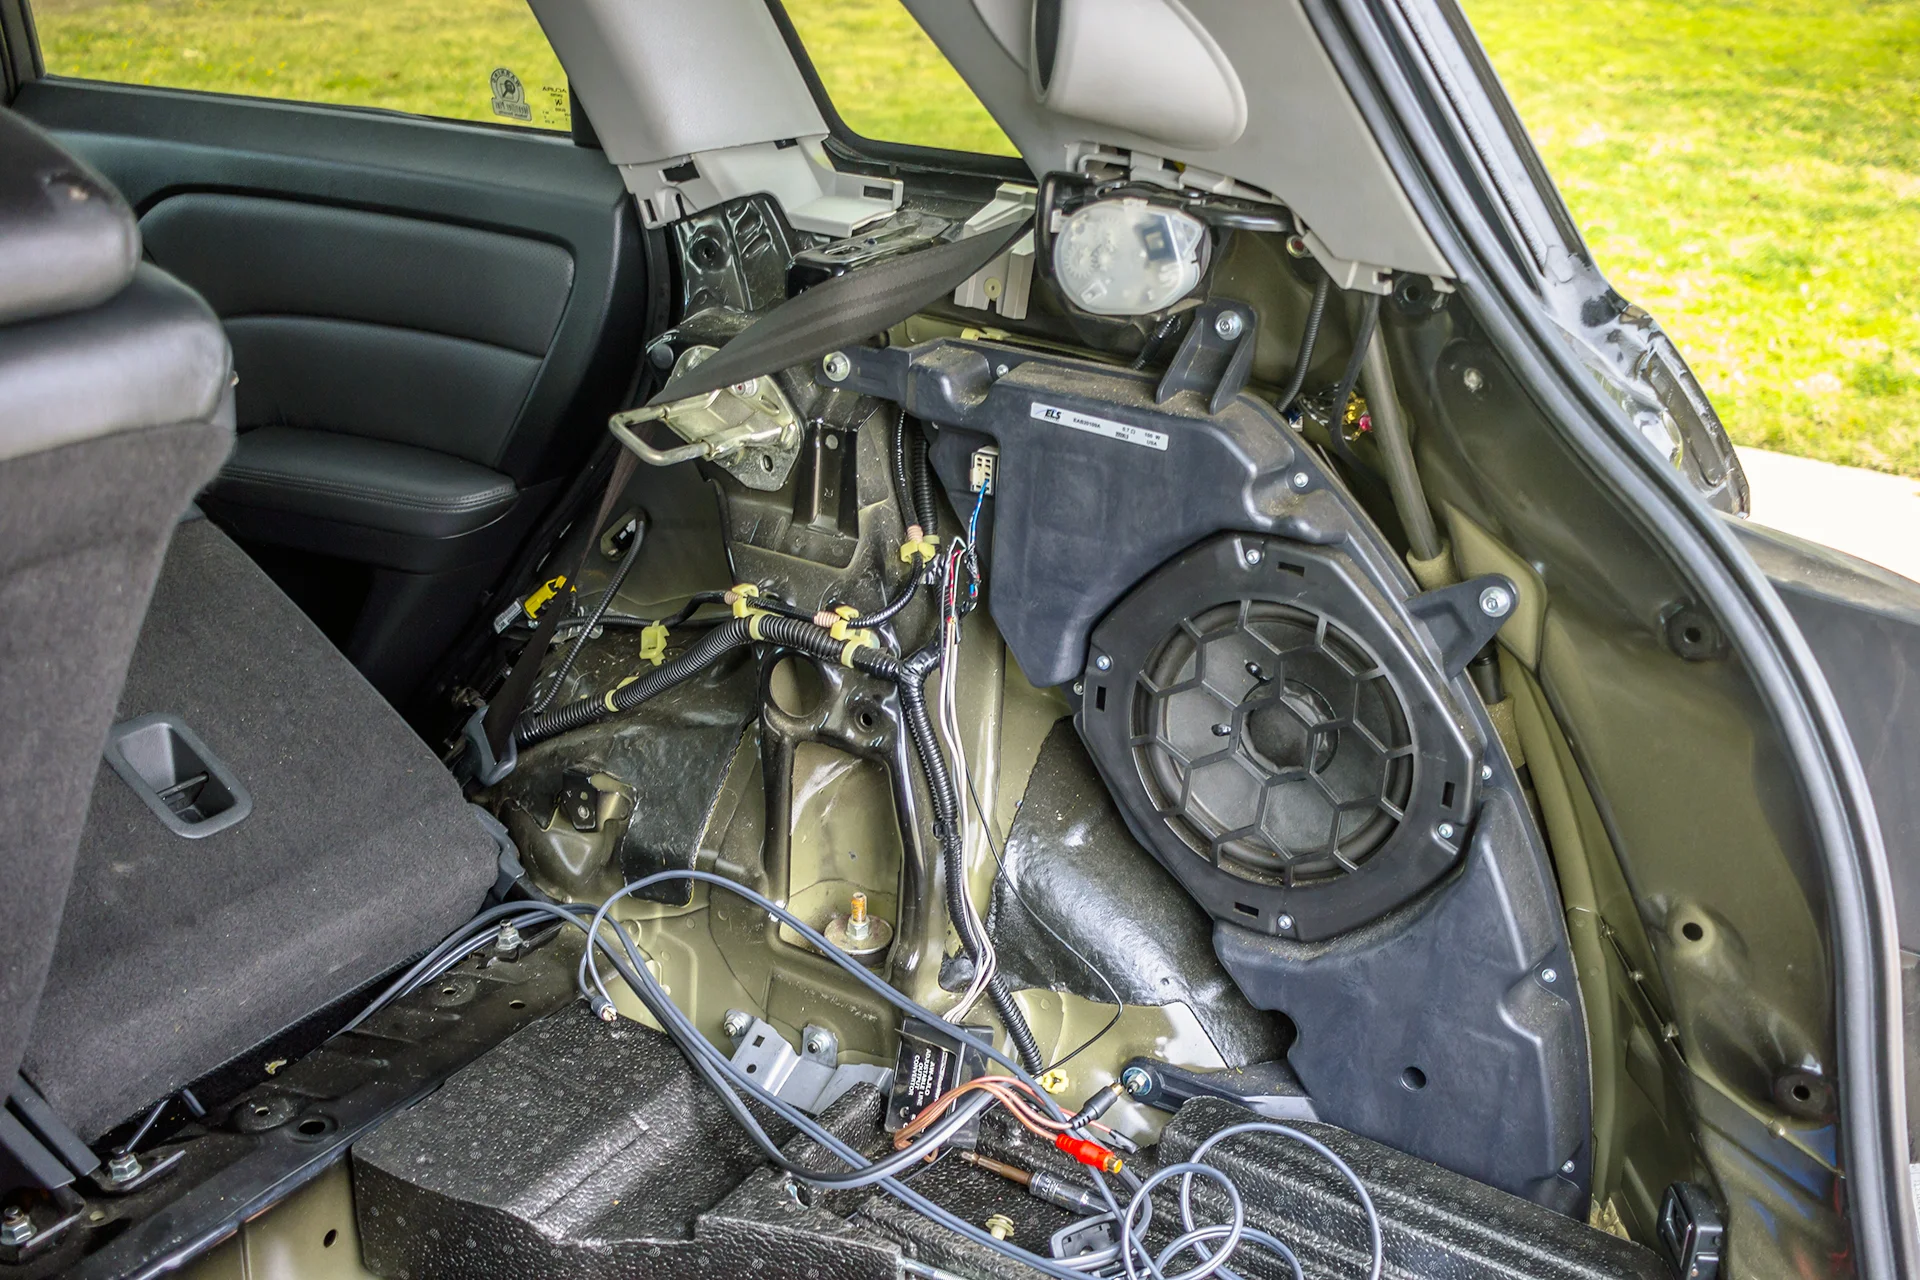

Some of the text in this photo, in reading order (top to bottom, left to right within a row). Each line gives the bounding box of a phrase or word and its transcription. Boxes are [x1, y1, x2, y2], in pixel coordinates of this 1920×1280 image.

[1045, 409, 1061, 420] ELS
[909, 1054, 920, 1096] CONVERTOR
[914, 1062, 923, 1090] OUTPUT
[916, 1049, 931, 1106] ADJUSTABLE LINE
